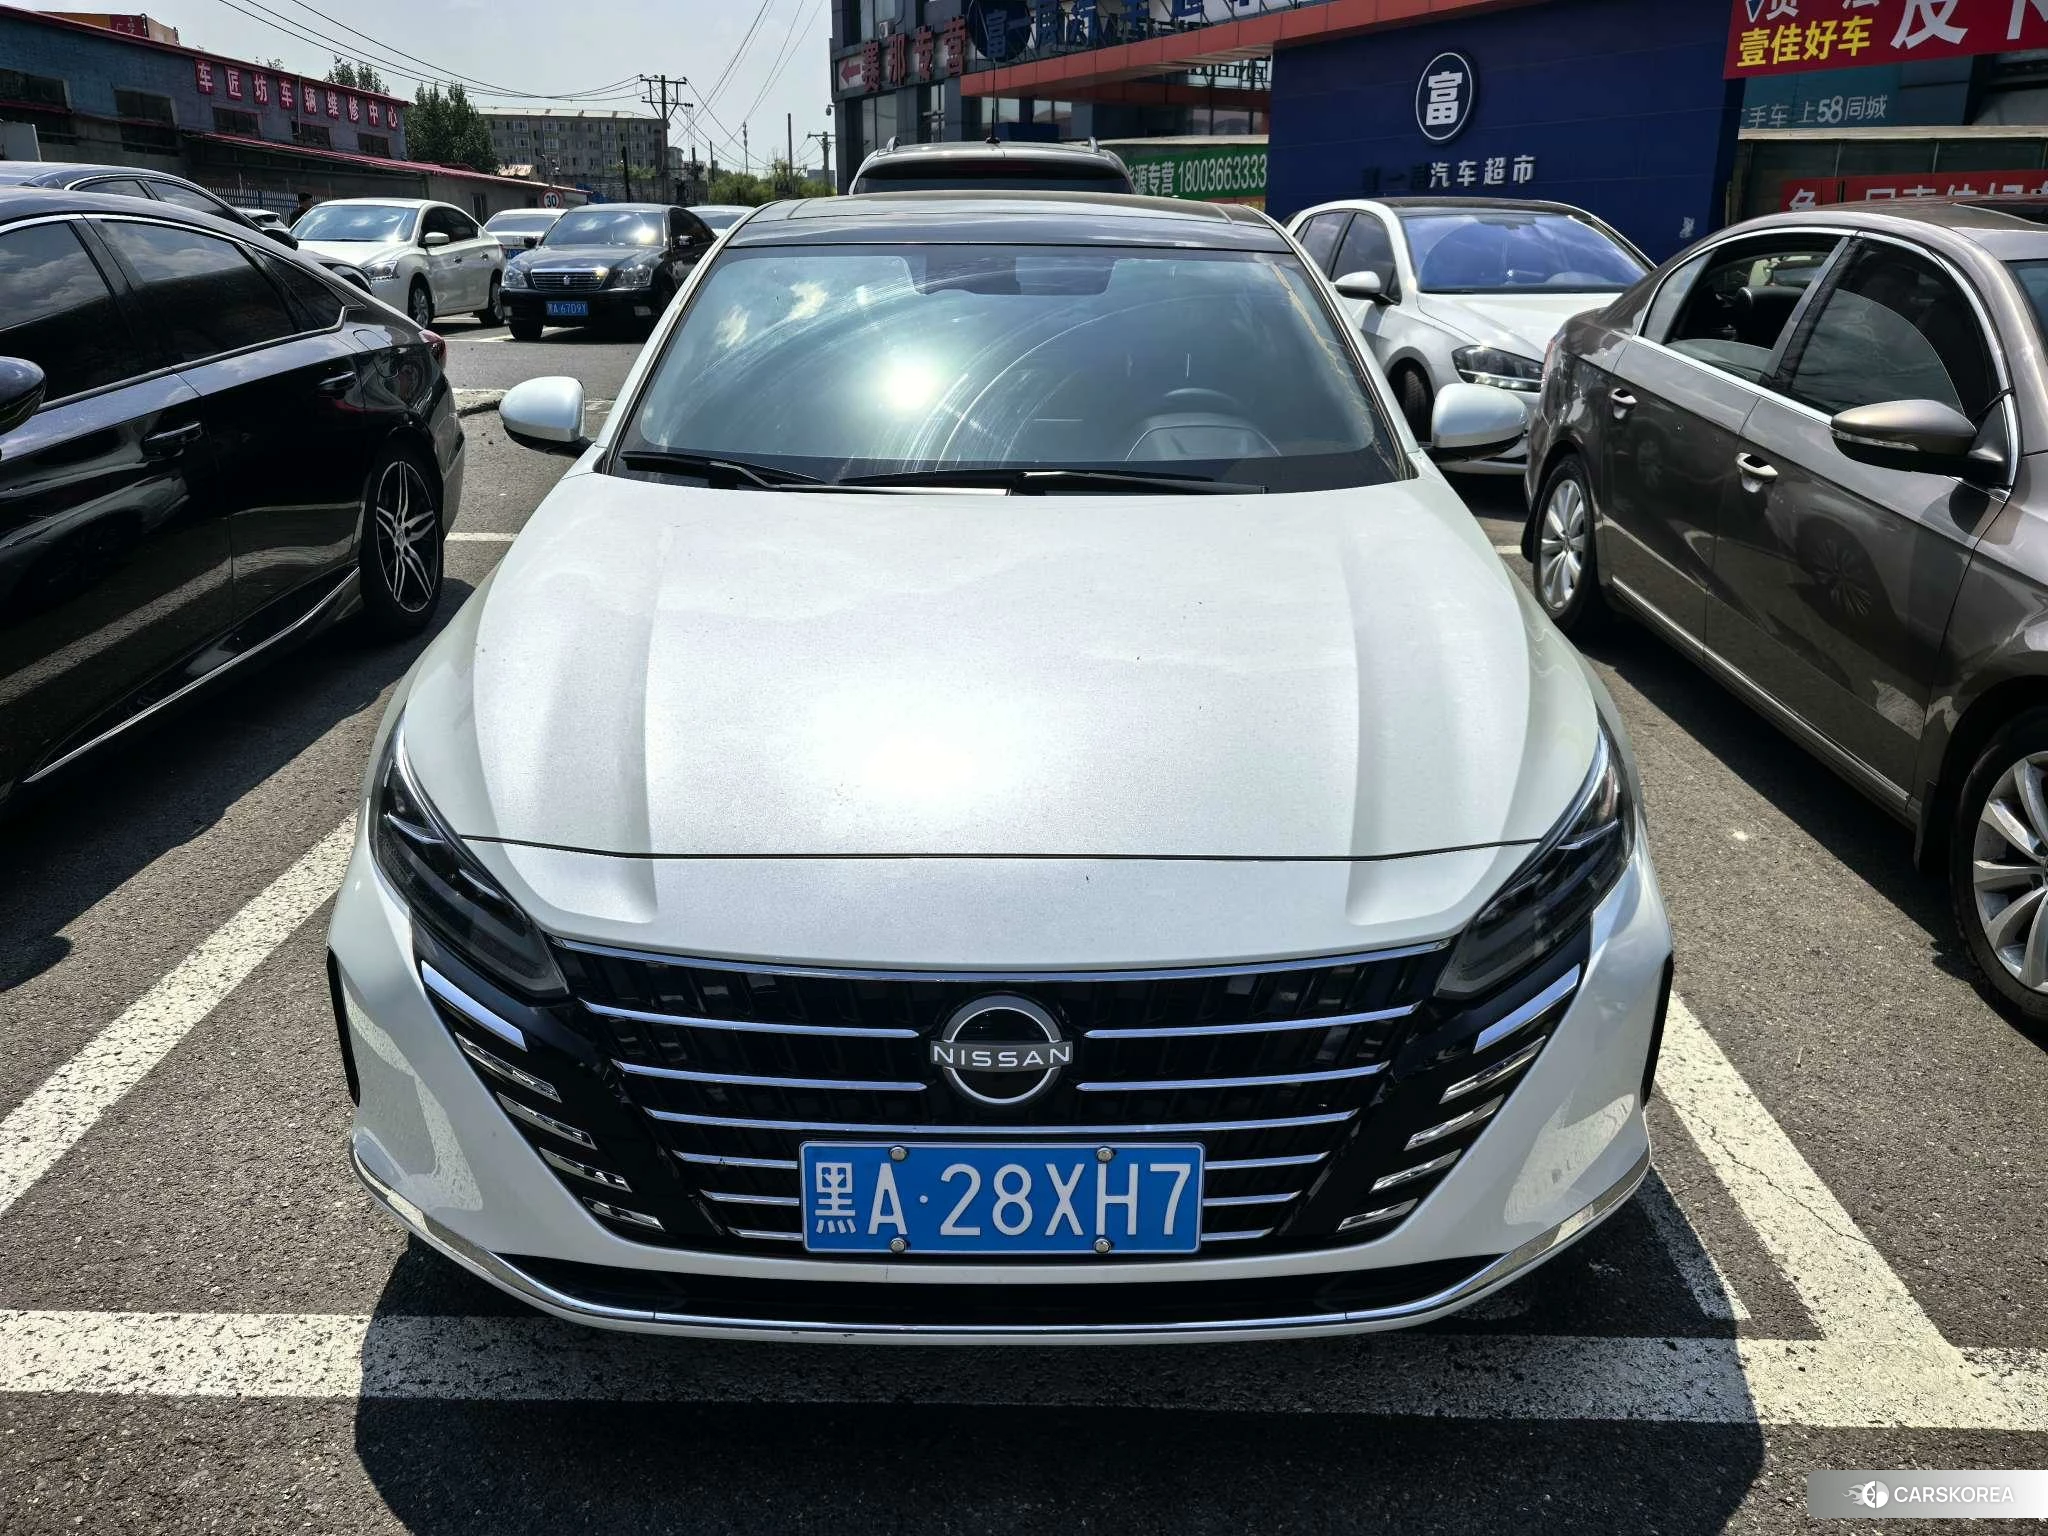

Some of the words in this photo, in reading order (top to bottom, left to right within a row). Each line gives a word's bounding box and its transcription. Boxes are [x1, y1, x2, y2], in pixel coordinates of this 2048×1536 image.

[1736, 15, 1873, 67] 壹佳好车
[197, 61, 398, 129] 车匠坊车辆维修中心
[1426, 71, 1463, 126] 富
[1741, 103, 1791, 128] 手车
[1178, 154, 1268, 193] 18003663333
[546, 195, 557, 208] 30
[933, 1045, 1070, 1067] NISSAN
